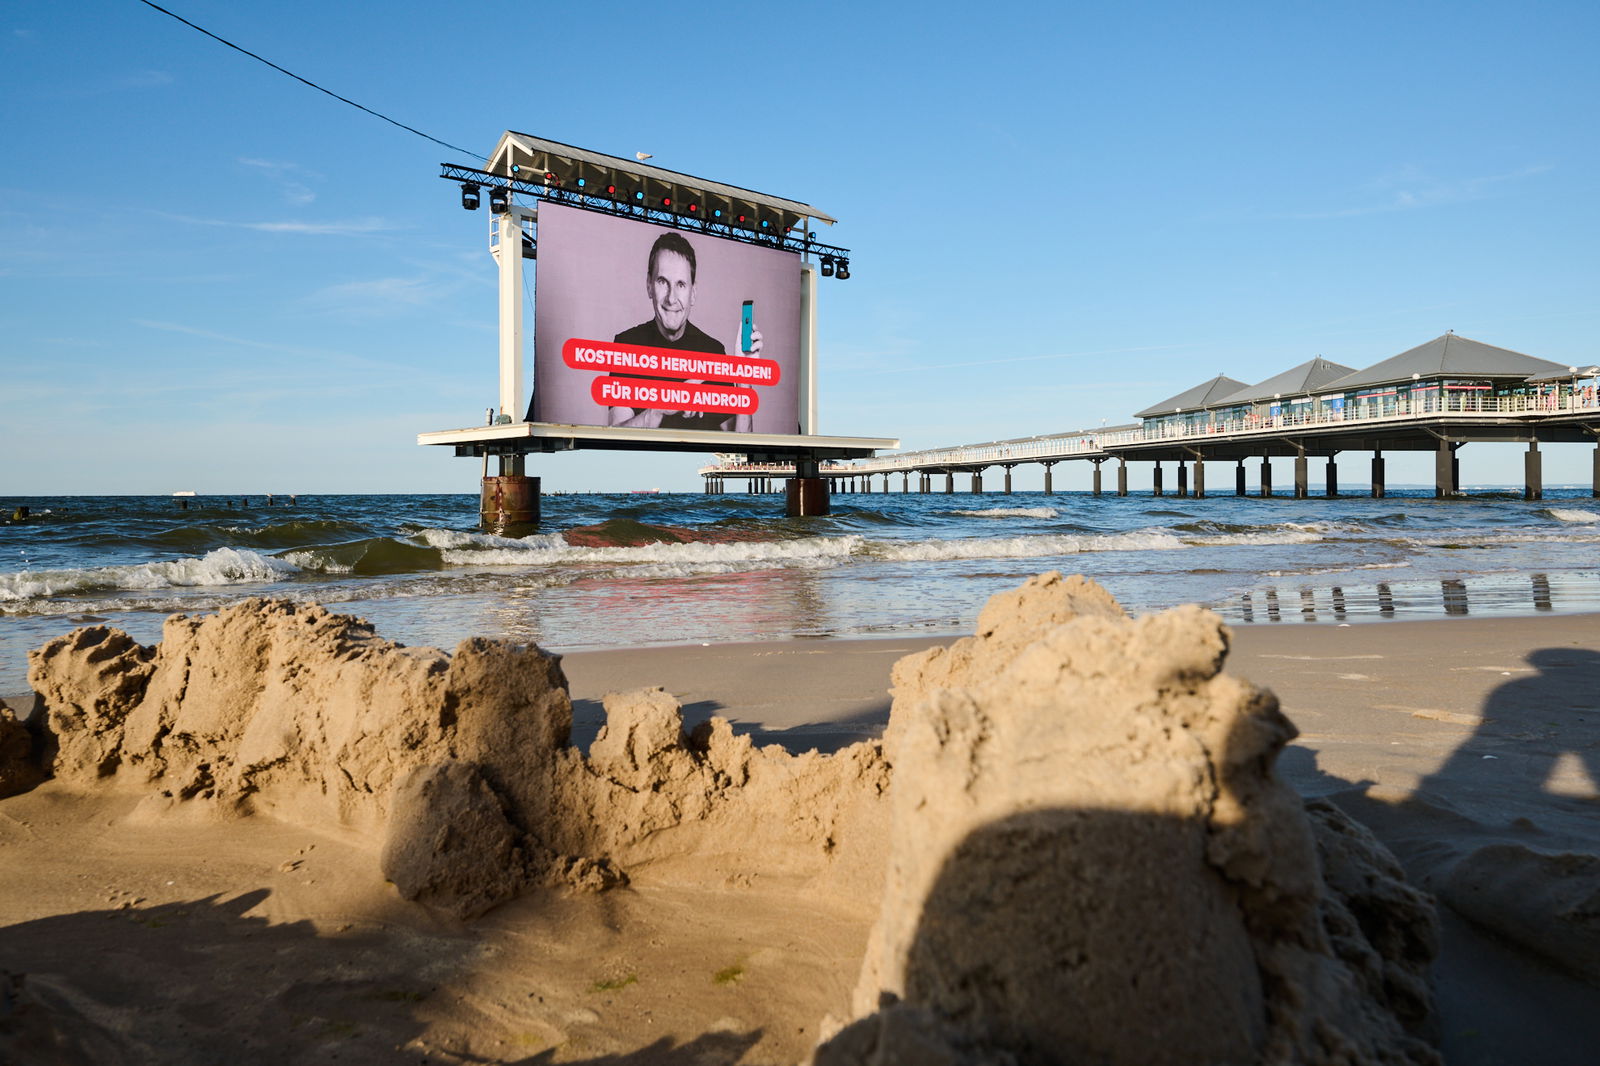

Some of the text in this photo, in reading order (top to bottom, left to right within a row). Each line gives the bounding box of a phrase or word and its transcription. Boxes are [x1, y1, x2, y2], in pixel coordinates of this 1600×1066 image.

[575, 347, 772, 380] KOSTENLOS HERUNTERLADEN!
[602, 381, 751, 408] FÜR IOS UND ANDROID
